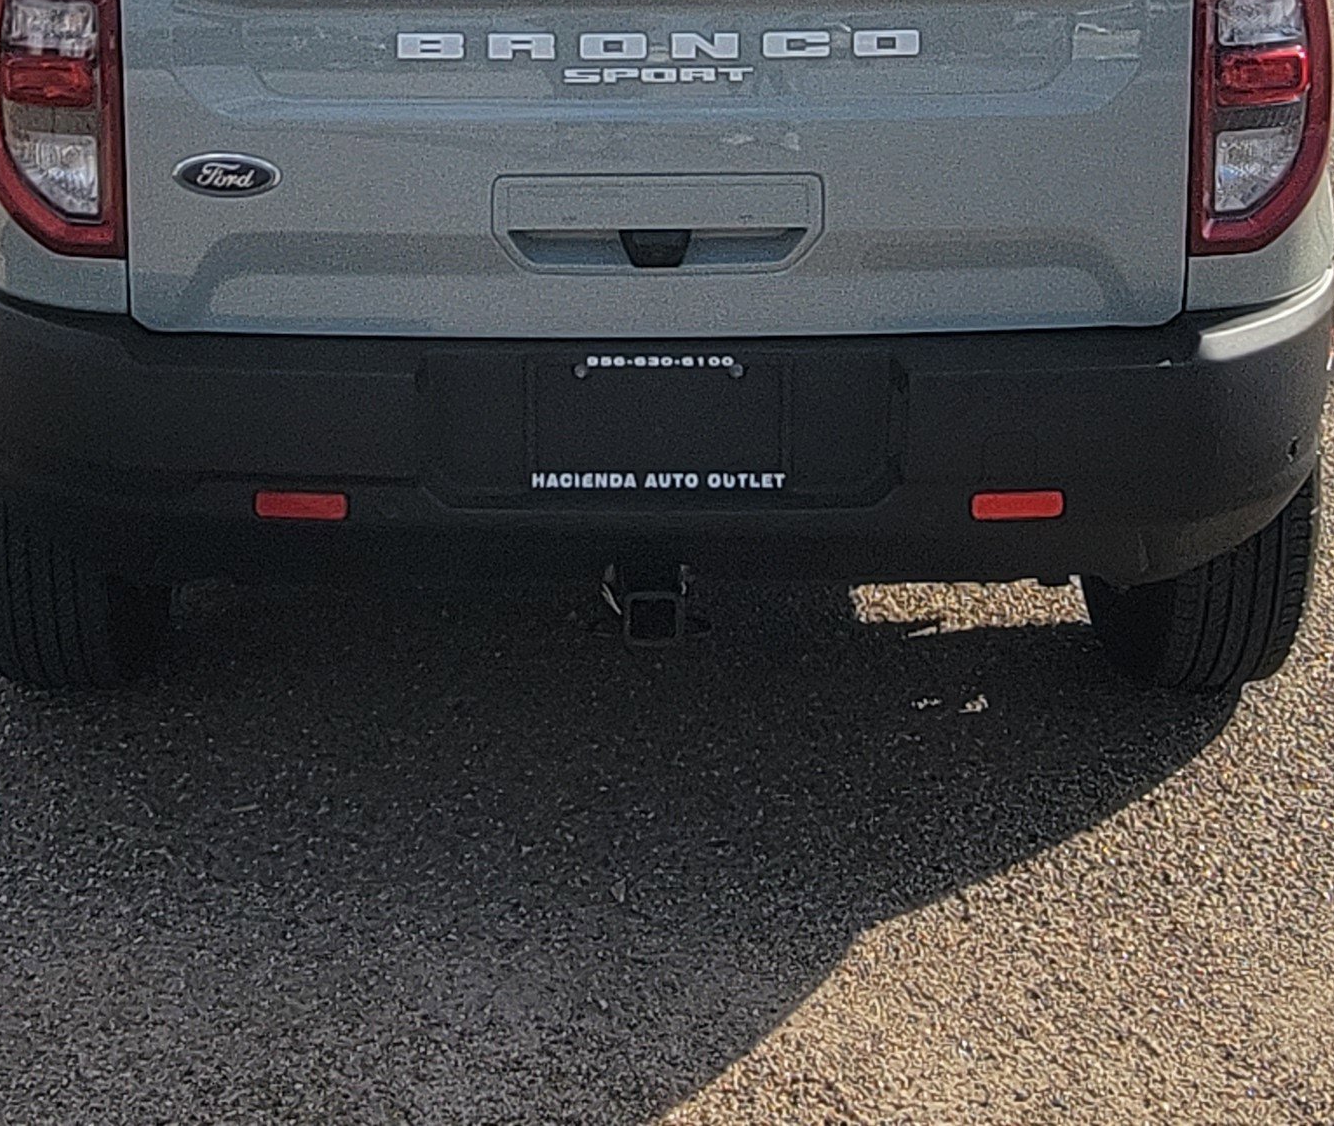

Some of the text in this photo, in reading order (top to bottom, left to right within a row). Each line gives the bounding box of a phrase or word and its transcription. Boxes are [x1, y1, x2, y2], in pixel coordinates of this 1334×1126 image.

[396, 29, 920, 60] BRONCO
[563, 67, 754, 84] SPORT
[196, 162, 255, 188] Ford
[531, 473, 786, 489] HACIENDA AUTO OUTLET
